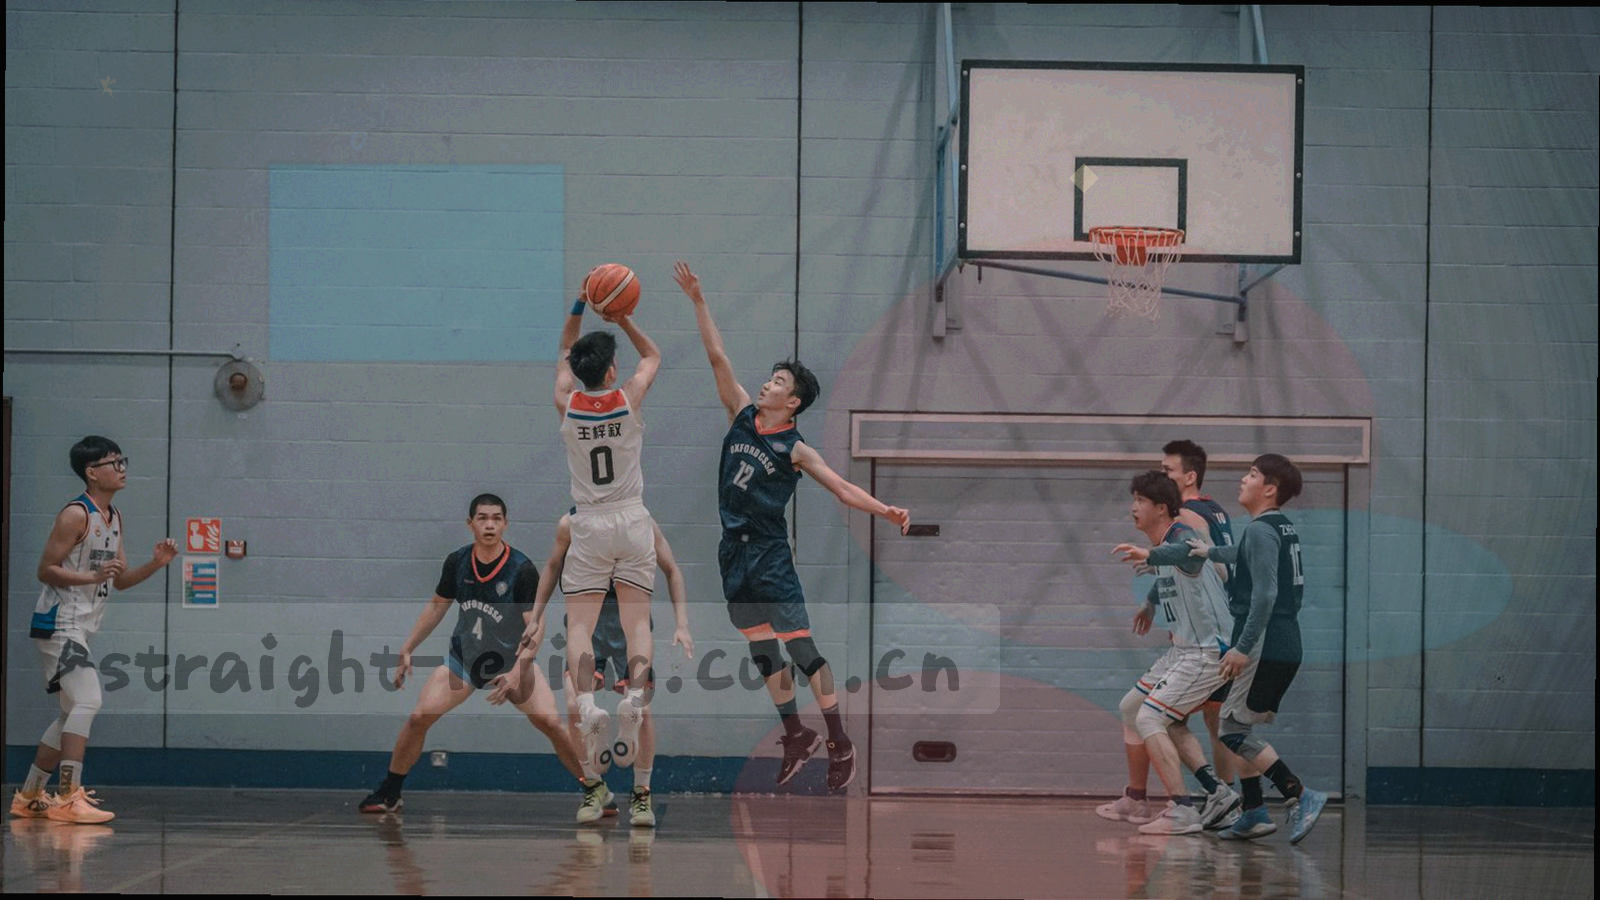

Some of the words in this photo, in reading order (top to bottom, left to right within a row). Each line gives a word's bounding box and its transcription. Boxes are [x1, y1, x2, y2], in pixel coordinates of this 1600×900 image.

[590, 445, 614, 485] 0
[733, 460, 755, 491] 12
[472, 616, 483, 640] 4
